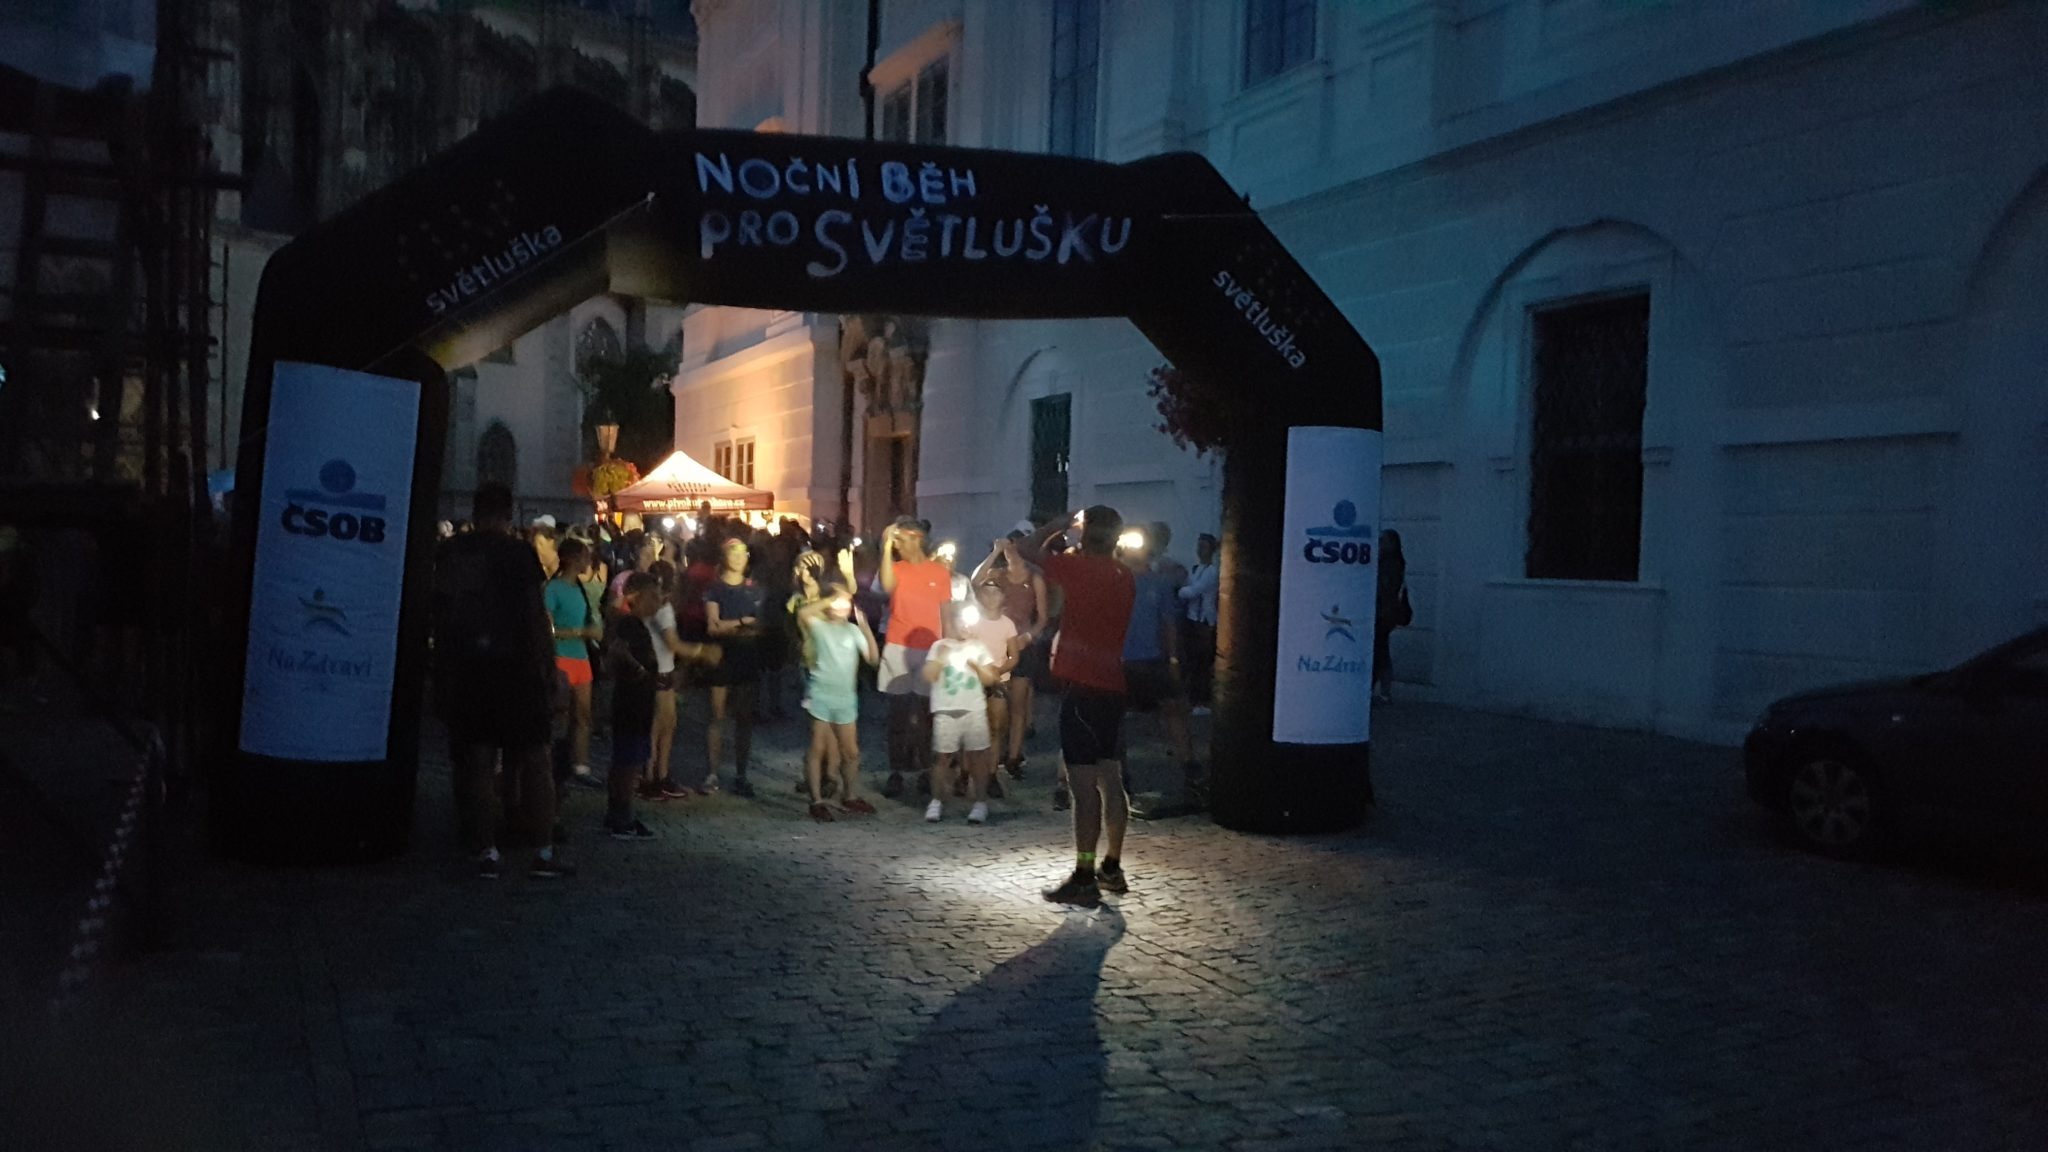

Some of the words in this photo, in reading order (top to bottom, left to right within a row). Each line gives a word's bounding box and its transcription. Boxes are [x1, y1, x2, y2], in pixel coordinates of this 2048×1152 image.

[694, 152, 861, 200] NOČNÍ
[880, 161, 977, 204] BĚH
[425, 224, 563, 313] světluška
[700, 210, 800, 260] PRO
[806, 204, 1133, 279] SVĚTLUŠKU
[1211, 270, 1307, 369] světluška
[281, 500, 386, 544] ČSOB
[1303, 537, 1371, 565] ČSOB
